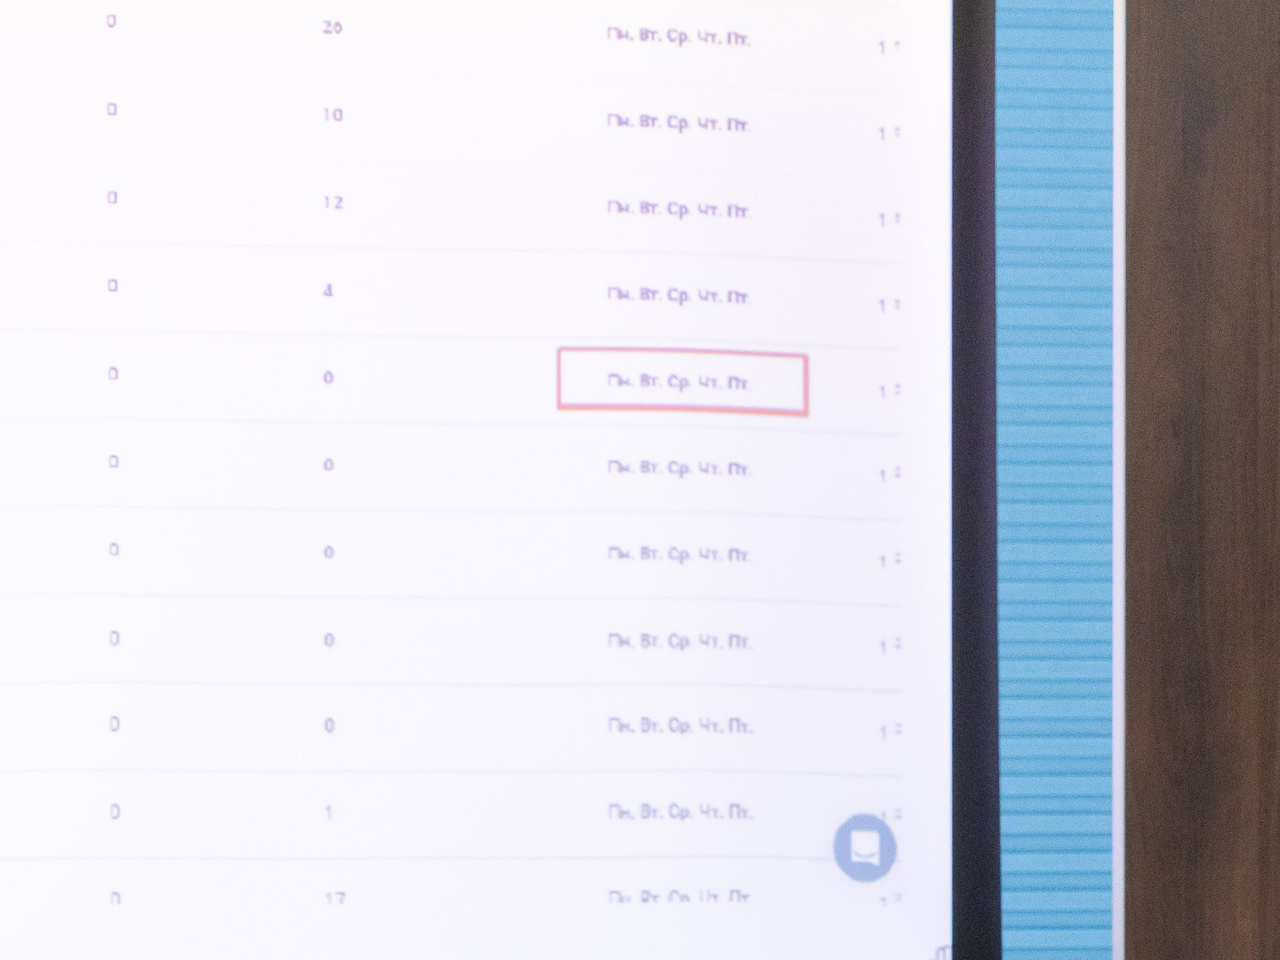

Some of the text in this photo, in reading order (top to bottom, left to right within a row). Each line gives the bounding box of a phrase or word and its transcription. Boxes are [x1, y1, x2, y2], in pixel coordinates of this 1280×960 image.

[323, 283, 333, 297] 4
[322, 370, 334, 385] 0
[323, 458, 334, 471] 0
[323, 545, 335, 559] 0
[323, 632, 335, 648] 0
[324, 717, 336, 734] 0
[325, 805, 332, 819] 1
